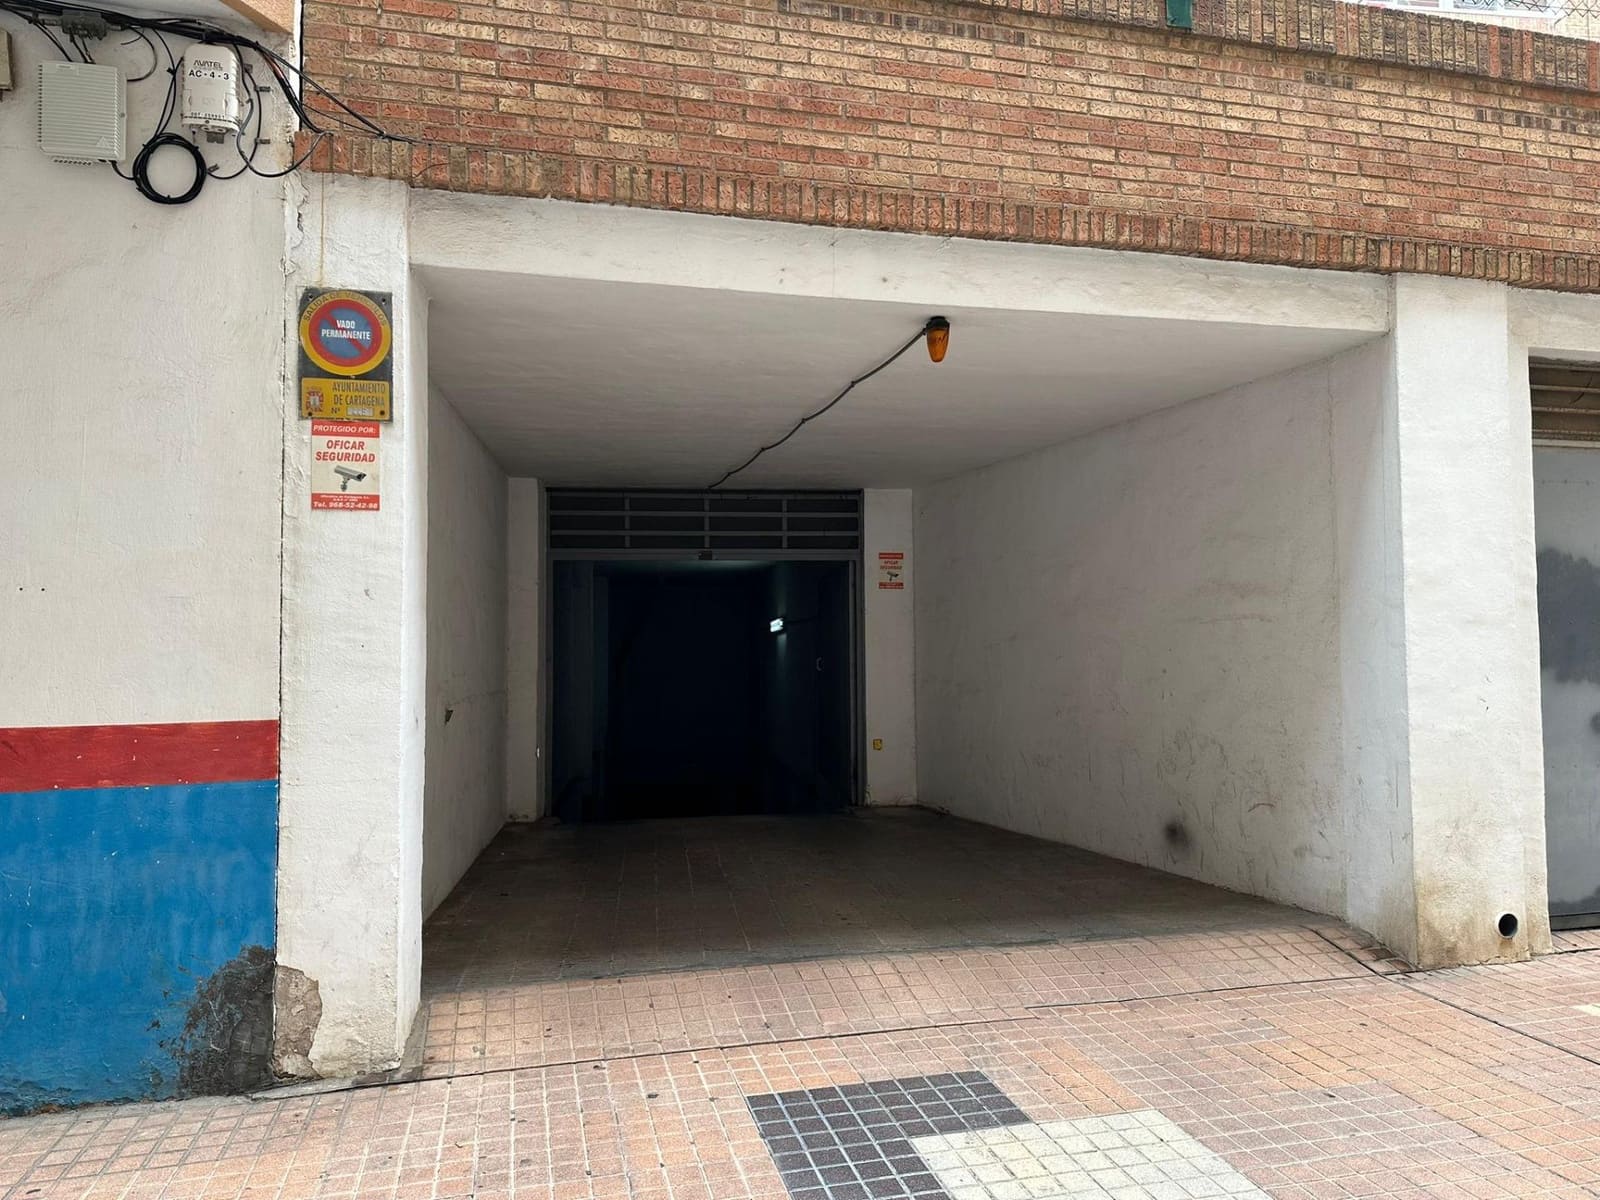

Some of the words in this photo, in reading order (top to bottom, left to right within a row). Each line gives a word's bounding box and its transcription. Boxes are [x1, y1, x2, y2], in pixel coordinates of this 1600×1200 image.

[193, 60, 223, 69] AVATEL
[337, 320, 355, 329] VADO
[321, 328, 371, 340] PERMANENTE
[332, 381, 385, 393] AYUNTAMIENTO
[333, 394, 343, 405] DE
[345, 395, 384, 406] CARTAGENA
[313, 424, 356, 433] PROTEGIDO
[358, 426, 376, 434] POR:
[326, 440, 365, 450] OFICAR
[315, 451, 375, 462] SEGURIDAD
